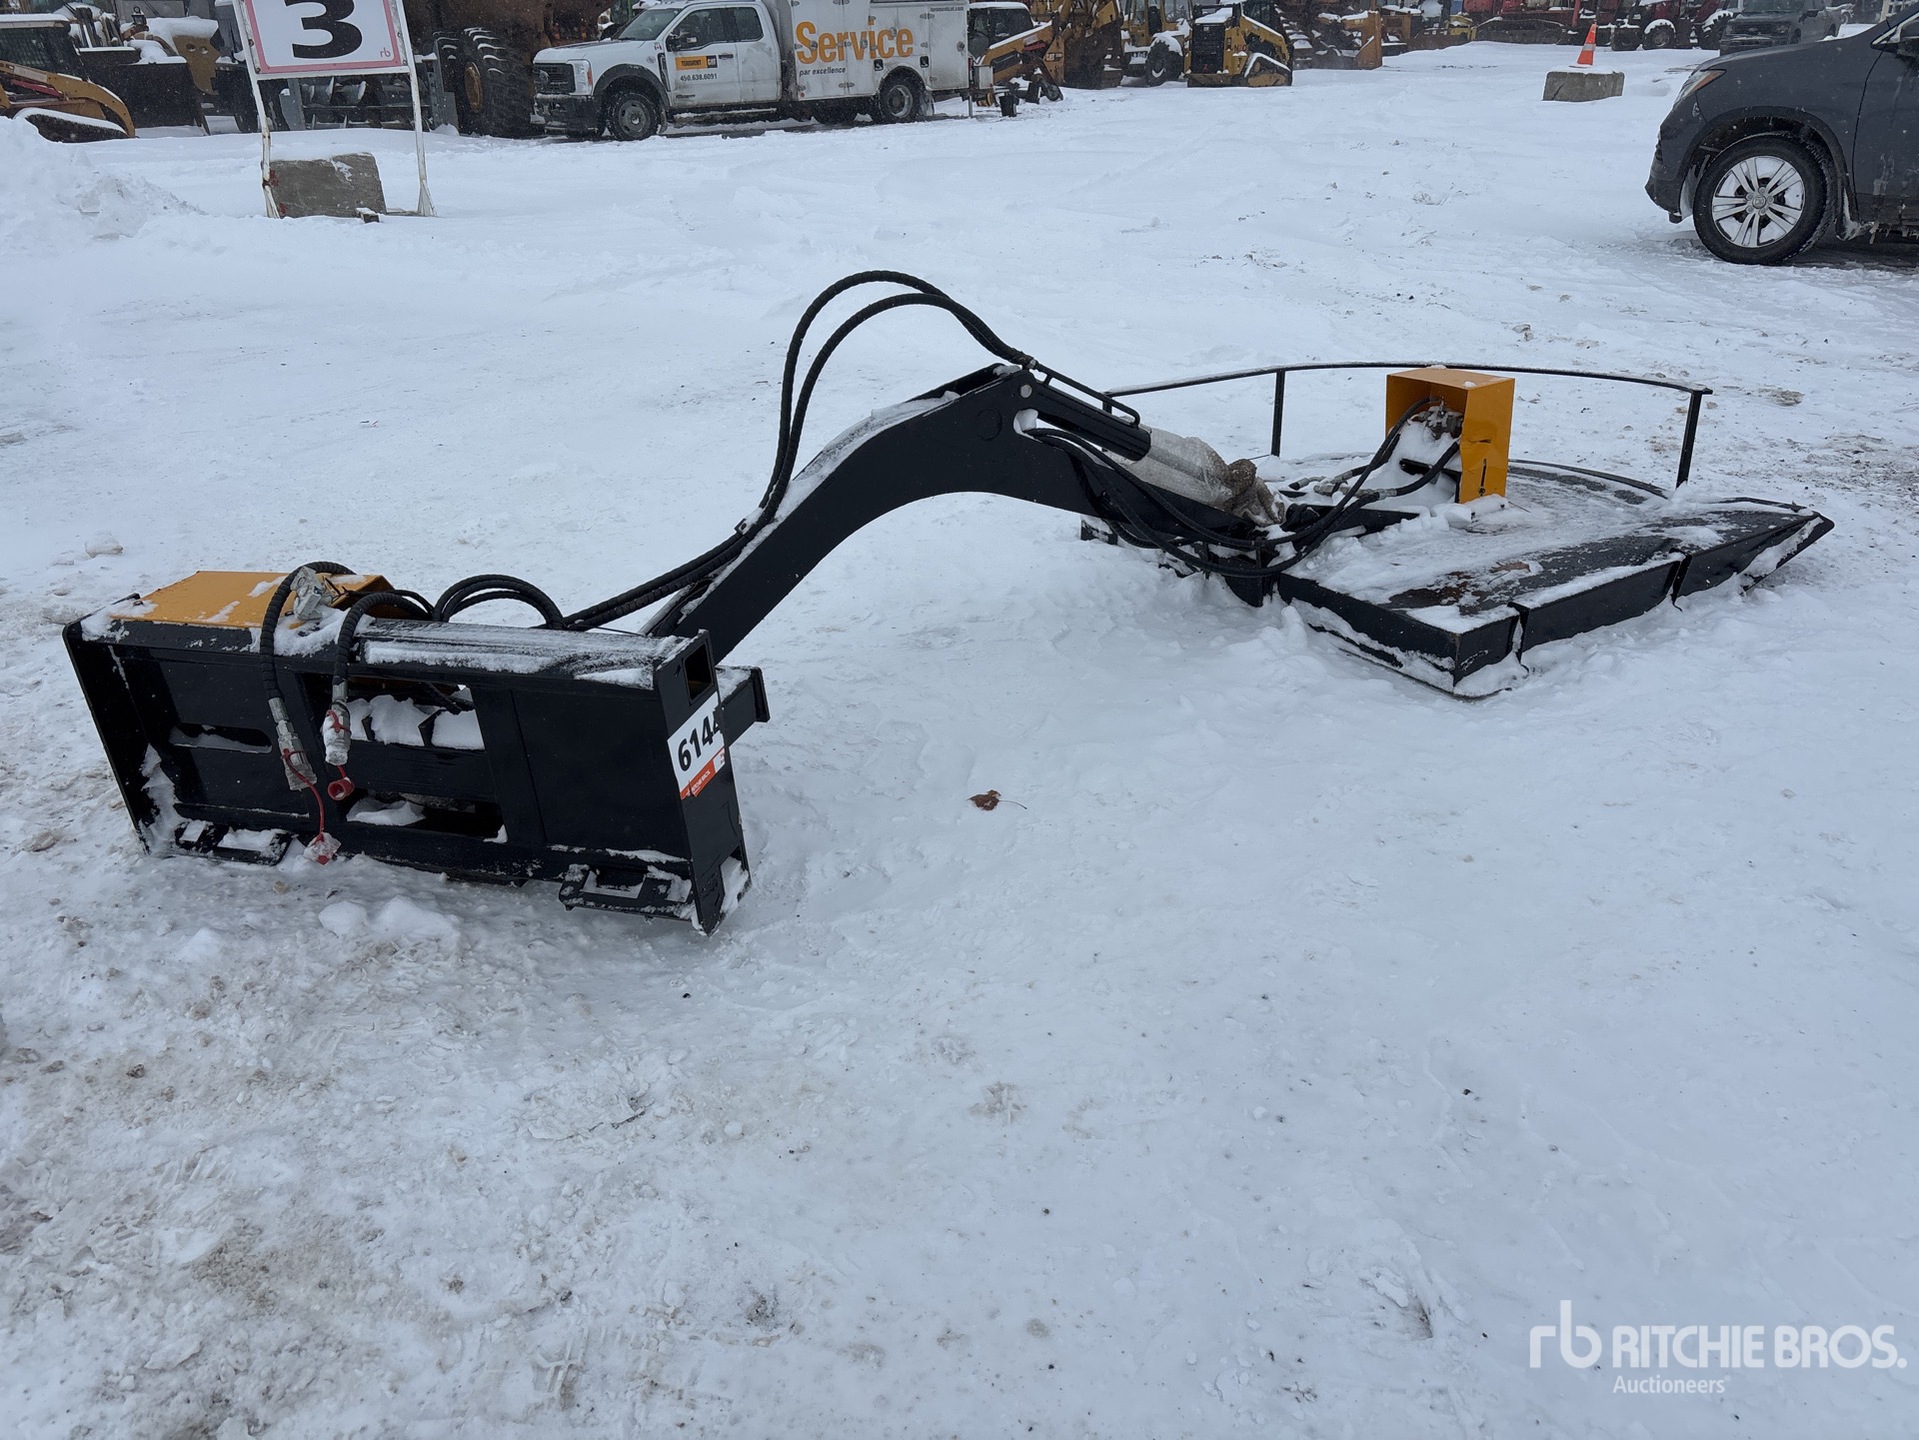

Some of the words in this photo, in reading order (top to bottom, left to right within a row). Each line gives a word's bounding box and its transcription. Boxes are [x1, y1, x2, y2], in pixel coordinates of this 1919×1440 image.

[284, 0, 363, 59] 3
[796, 17, 914, 64] Service
[379, 47, 391, 57] rb
[812, 66, 846, 75] excellence
